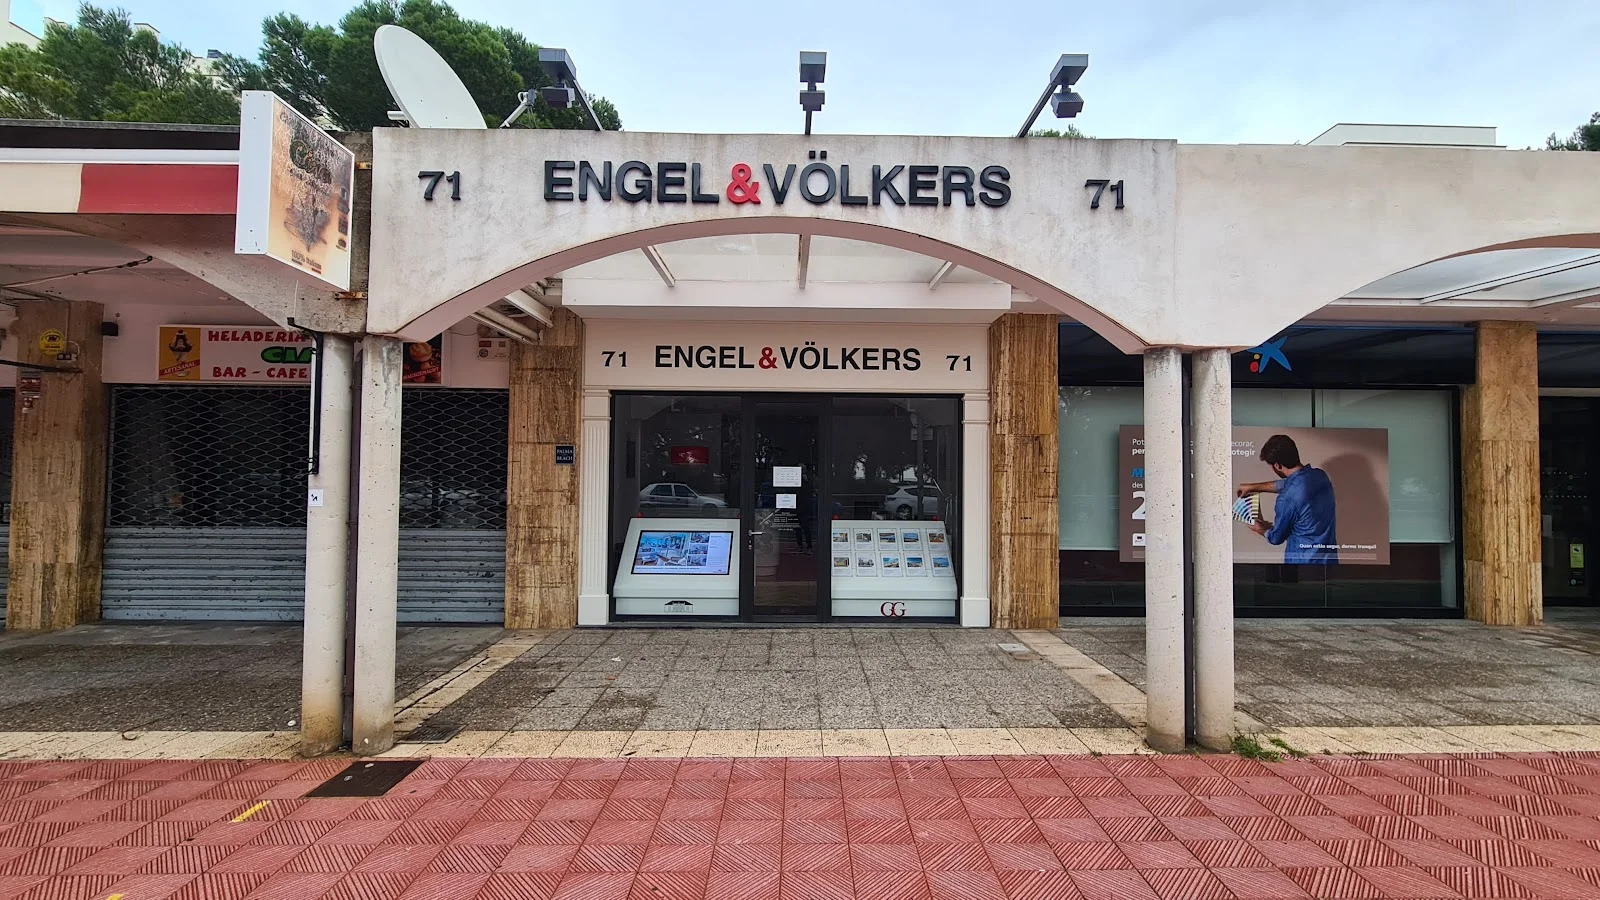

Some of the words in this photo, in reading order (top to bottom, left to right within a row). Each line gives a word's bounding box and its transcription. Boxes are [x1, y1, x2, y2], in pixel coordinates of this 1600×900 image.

[418, 171, 461, 201] 71
[1084, 179, 1125, 209] 71
[601, 351, 627, 368] 71
[946, 355, 972, 372] 71
[163, 361, 197, 375] ARTESANAL
[212, 366, 247, 378] BAR
[1231, 440, 1254, 448] ecorar,
[1231, 448, 1255, 458] otegir
